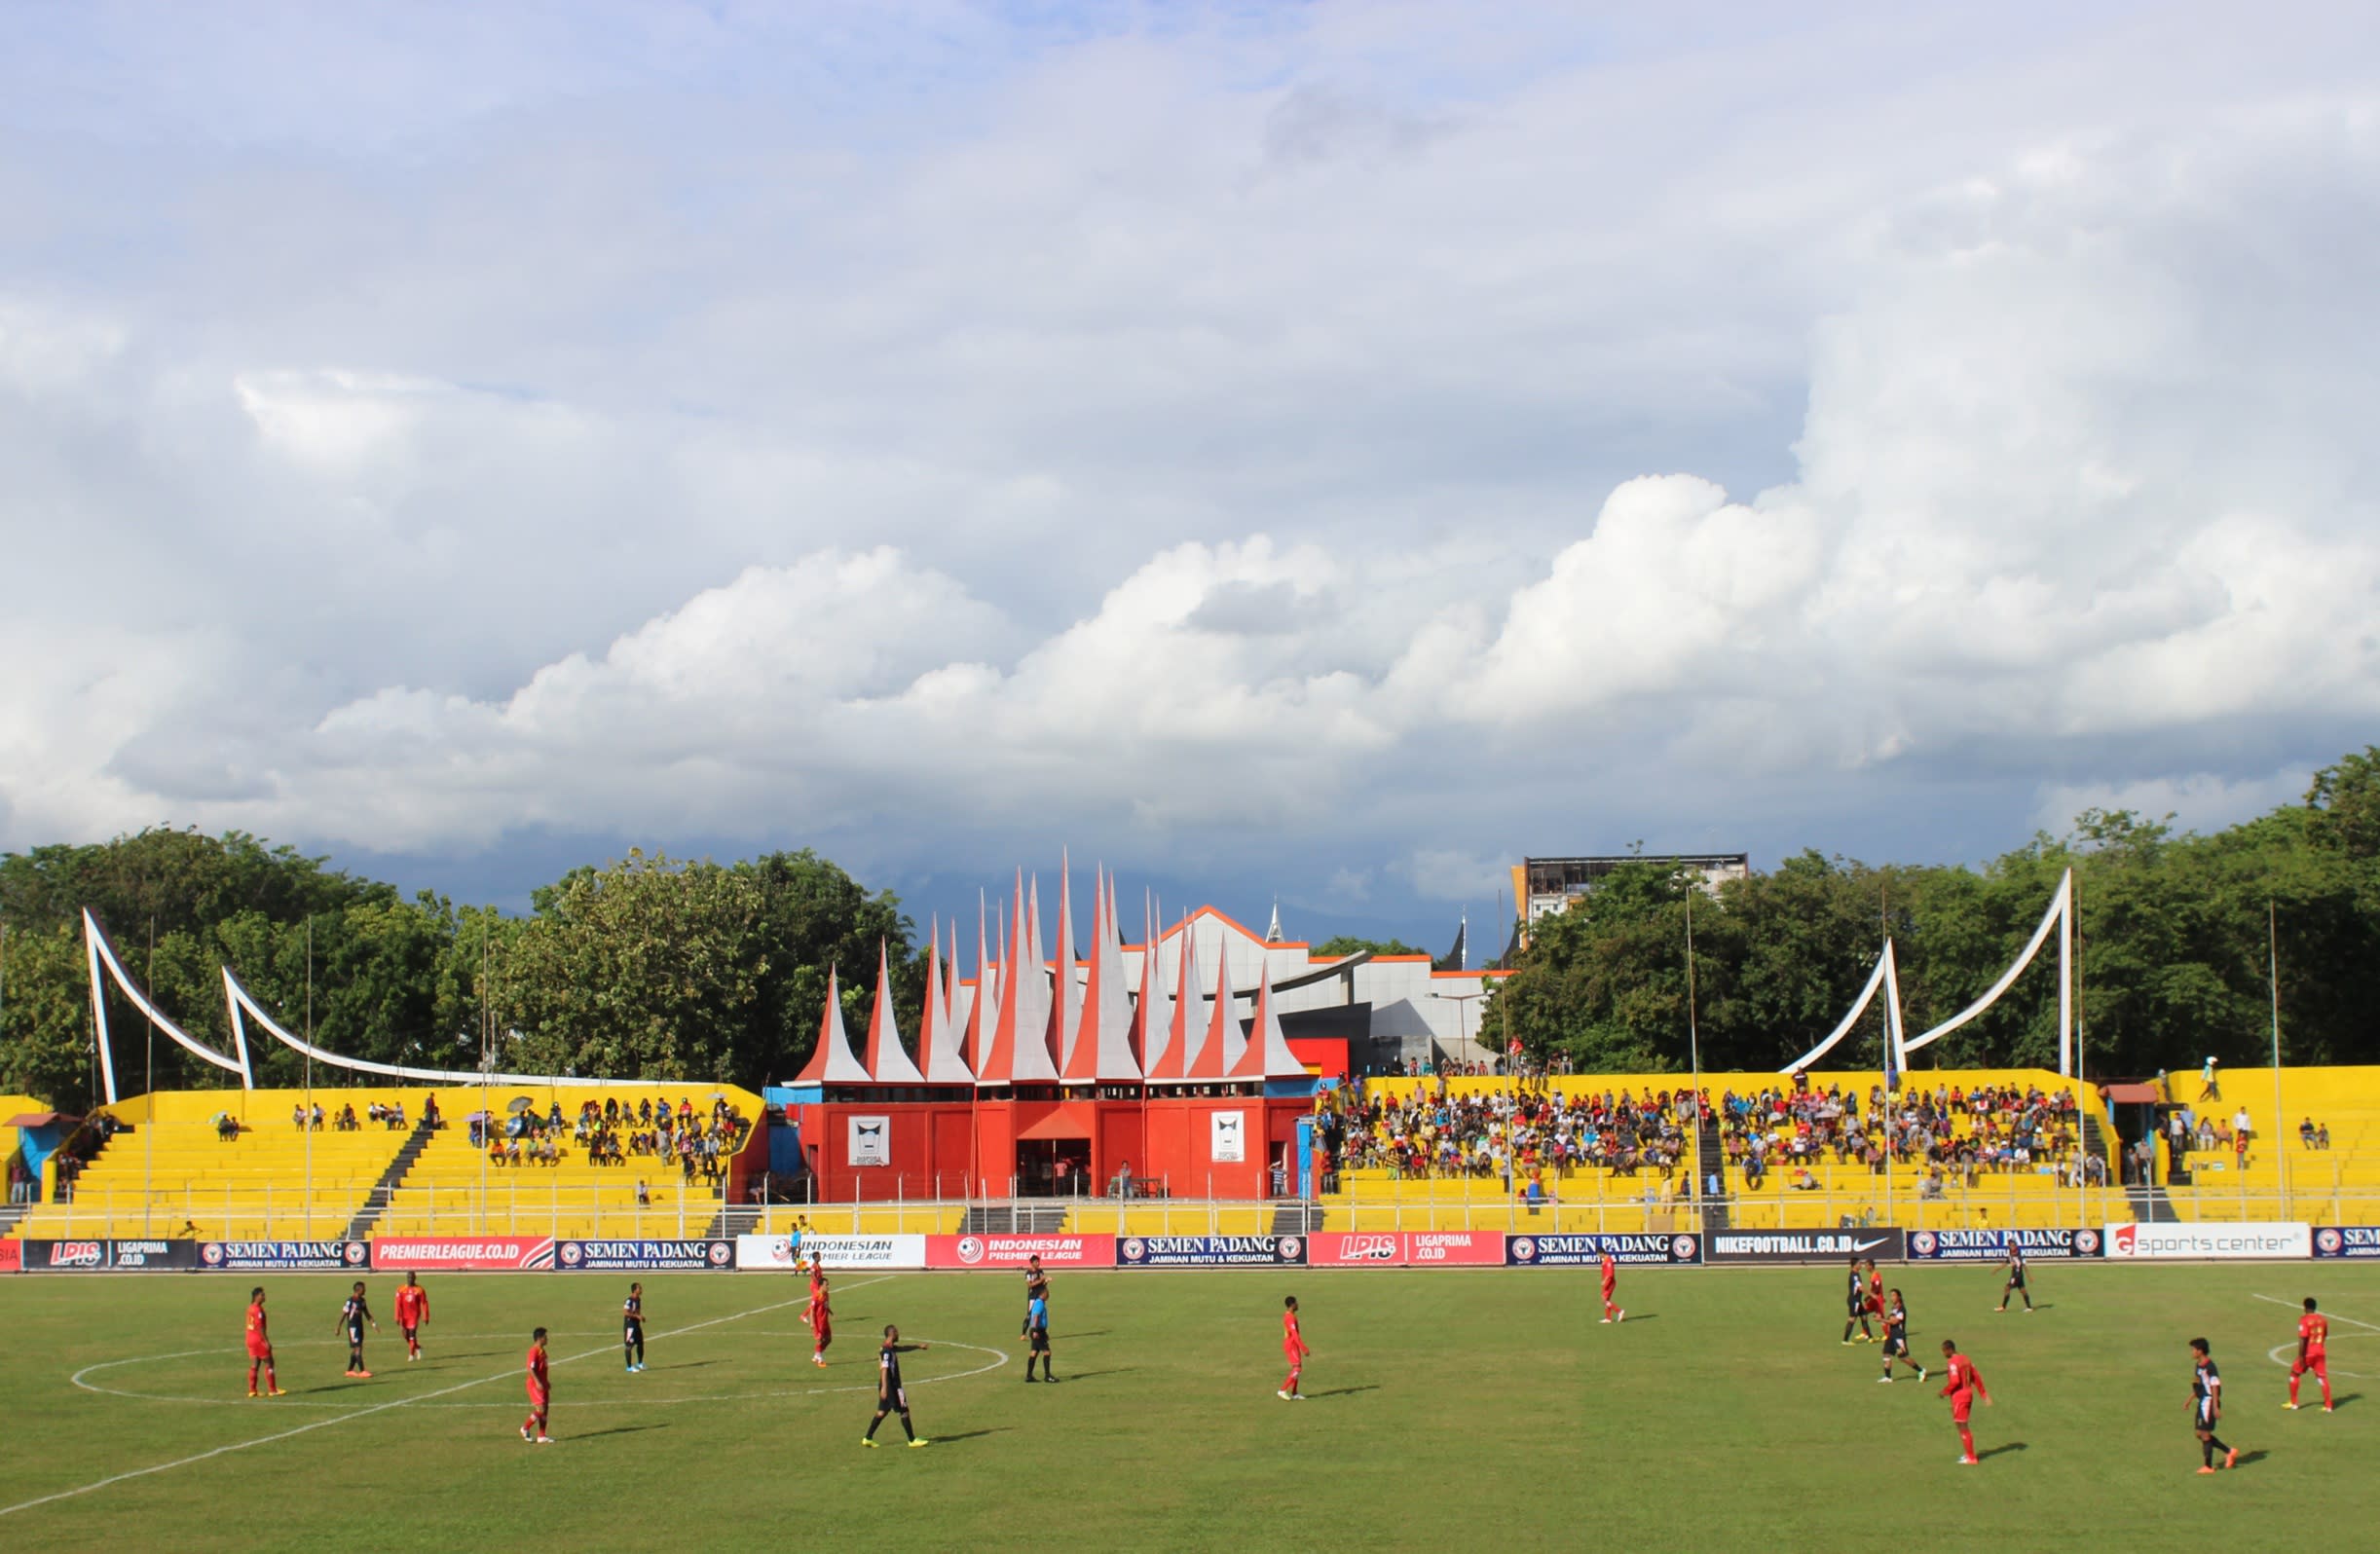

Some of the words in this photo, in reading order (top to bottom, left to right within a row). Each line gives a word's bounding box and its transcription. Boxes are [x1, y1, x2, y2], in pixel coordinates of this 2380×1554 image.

[1416, 1235, 1471, 1247] LIGAPRIMA
[1539, 1237, 1596, 1253] SEMEN
[1601, 1236, 1669, 1252] PADANG
[1715, 1236, 1852, 1253] NIKEFOOTBALL.CO.ID
[1939, 1231, 1997, 1247] SEMEN
[2003, 1230, 2071, 1246] PADANG
[117, 1241, 167, 1253] LIGAPRIMA
[226, 1242, 278, 1258] SEMEN
[282, 1242, 342, 1258] PADANG
[380, 1243, 519, 1259] PREMIERLEAGUE.CO.ID
[585, 1242, 639, 1258] SEMEN
[643, 1242, 706, 1258] PADANG
[801, 1240, 892, 1251] INDONESIAN
[988, 1240, 1082, 1250] INDONESIAN
[1148, 1238, 1205, 1253] SEMEN
[1209, 1237, 1275, 1253] PADANG
[1041, 1251, 1082, 1260] LEAGUE
[1416, 1247, 1445, 1260] .CO.ID
[1540, 1254, 1580, 1263] JAMINAN
[1582, 1254, 1602, 1263] MUT
[1619, 1254, 1667, 1263] KEKUATAN
[1941, 1248, 1981, 1258] JAMINAN
[1984, 1248, 2010, 1257] MUTU
[2021, 1247, 2070, 1257] KEKUATAN
[118, 1254, 144, 1266] .CO.ID
[585, 1260, 623, 1269] JAMINAN
[1149, 1255, 1189, 1264] JAMINAN
[1226, 1254, 1274, 1263] KEKUATAN
